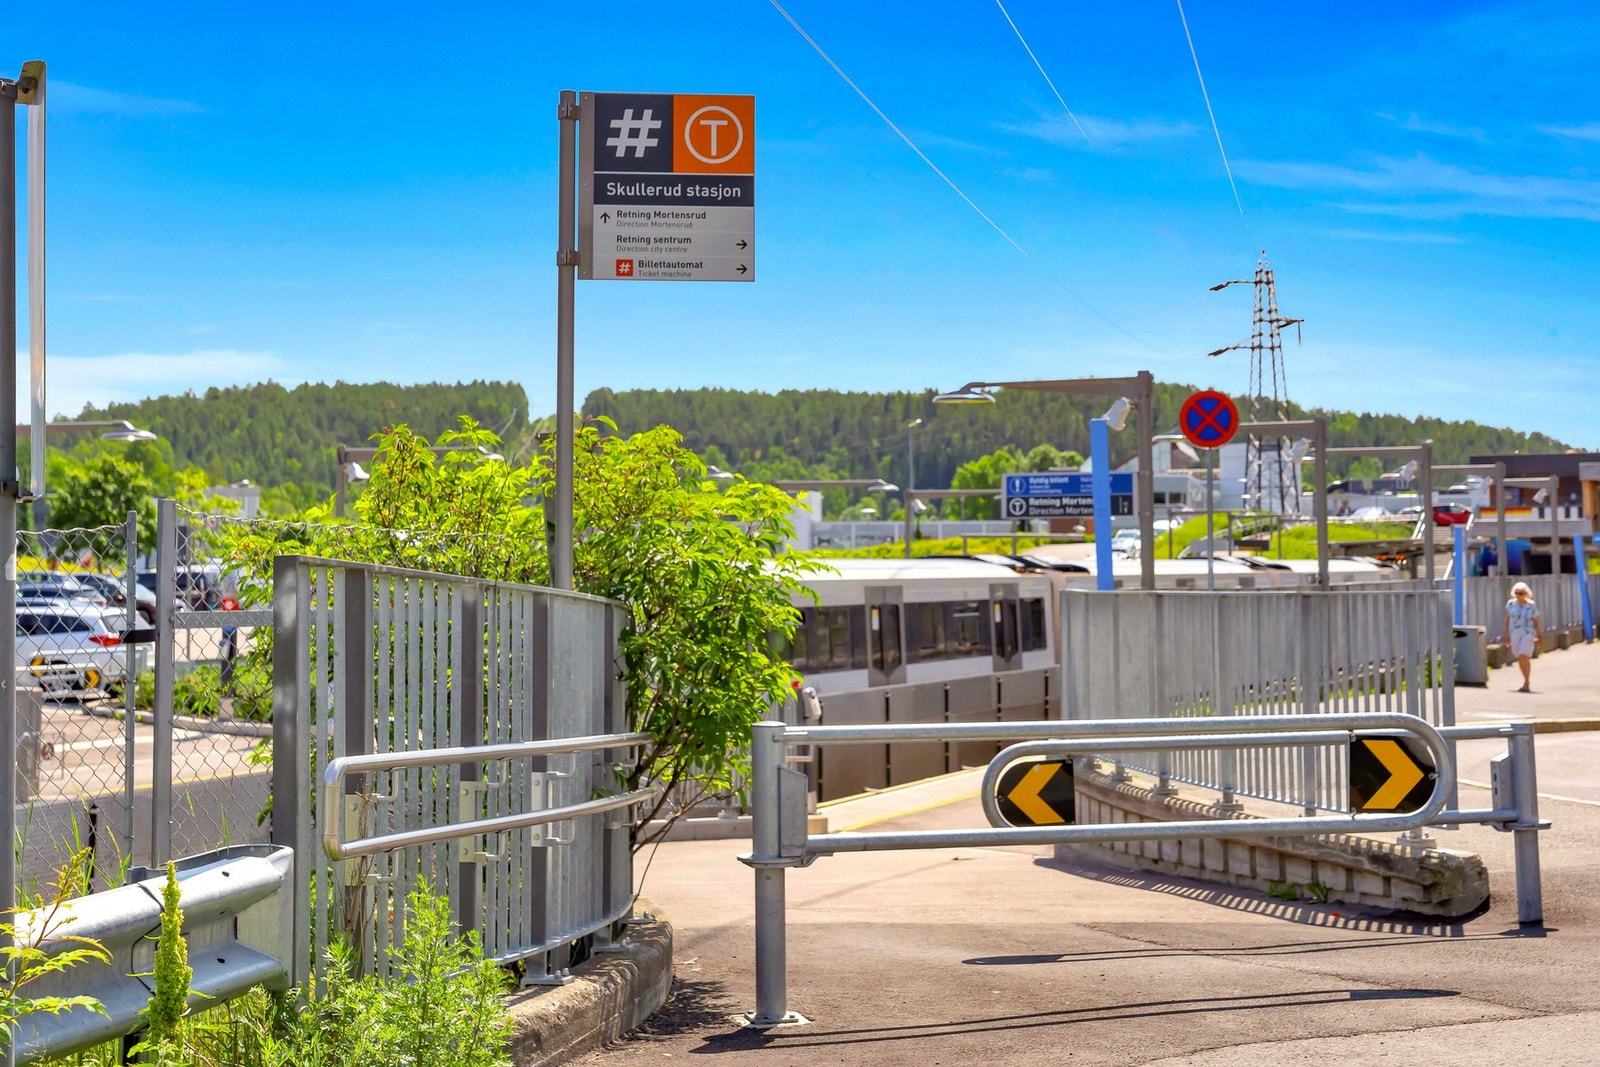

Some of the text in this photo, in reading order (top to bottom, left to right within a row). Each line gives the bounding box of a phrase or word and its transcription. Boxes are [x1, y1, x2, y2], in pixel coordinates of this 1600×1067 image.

[606, 182, 741, 200] Skullerud stasjon
[616, 210, 707, 220] Retning Mortensrud
[651, 221, 693, 229] Mortensrud
[616, 235, 692, 245] Retning sentrum
[616, 245, 649, 253] Direction
[650, 245, 663, 254] city
[638, 259, 704, 270] Billettautomat
[661, 270, 692, 278] machine
[1029, 497, 1061, 507] Retning
